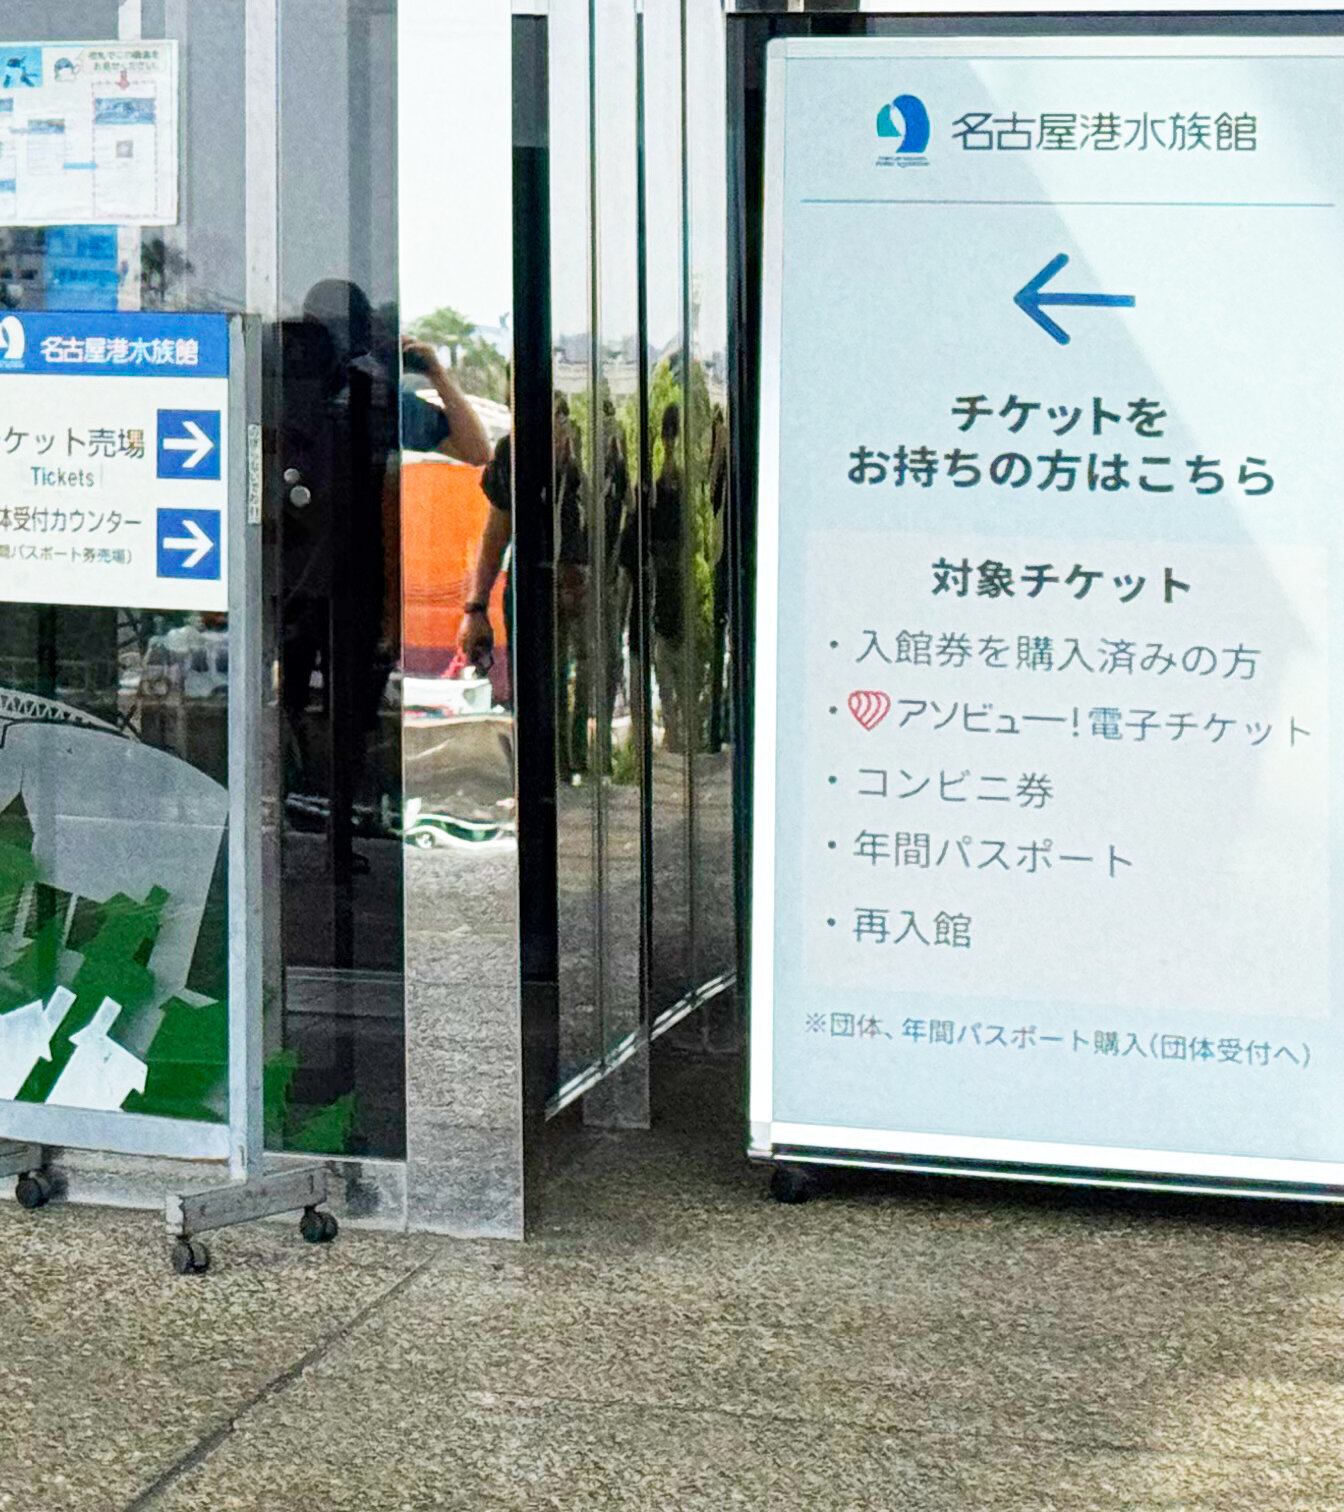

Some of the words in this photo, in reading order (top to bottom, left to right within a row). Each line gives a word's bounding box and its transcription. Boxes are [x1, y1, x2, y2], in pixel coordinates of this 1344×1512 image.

[951, 111, 1258, 152] 名古屋港水族館
[40, 336, 199, 365] 名古屋港水族館
[951, 394, 1168, 438] チケットを
[30, 466, 95, 487] Tickets
[847, 445, 1275, 496] お持ちの方はこちら
[931, 558, 1191, 603] 対象チケット
[855, 629, 1261, 680] 入館券を購入済みの方
[857, 768, 1054, 809] コンビニ券
[852, 830, 1133, 878] 年間パスポート
[852, 908, 973, 948] 再入館
